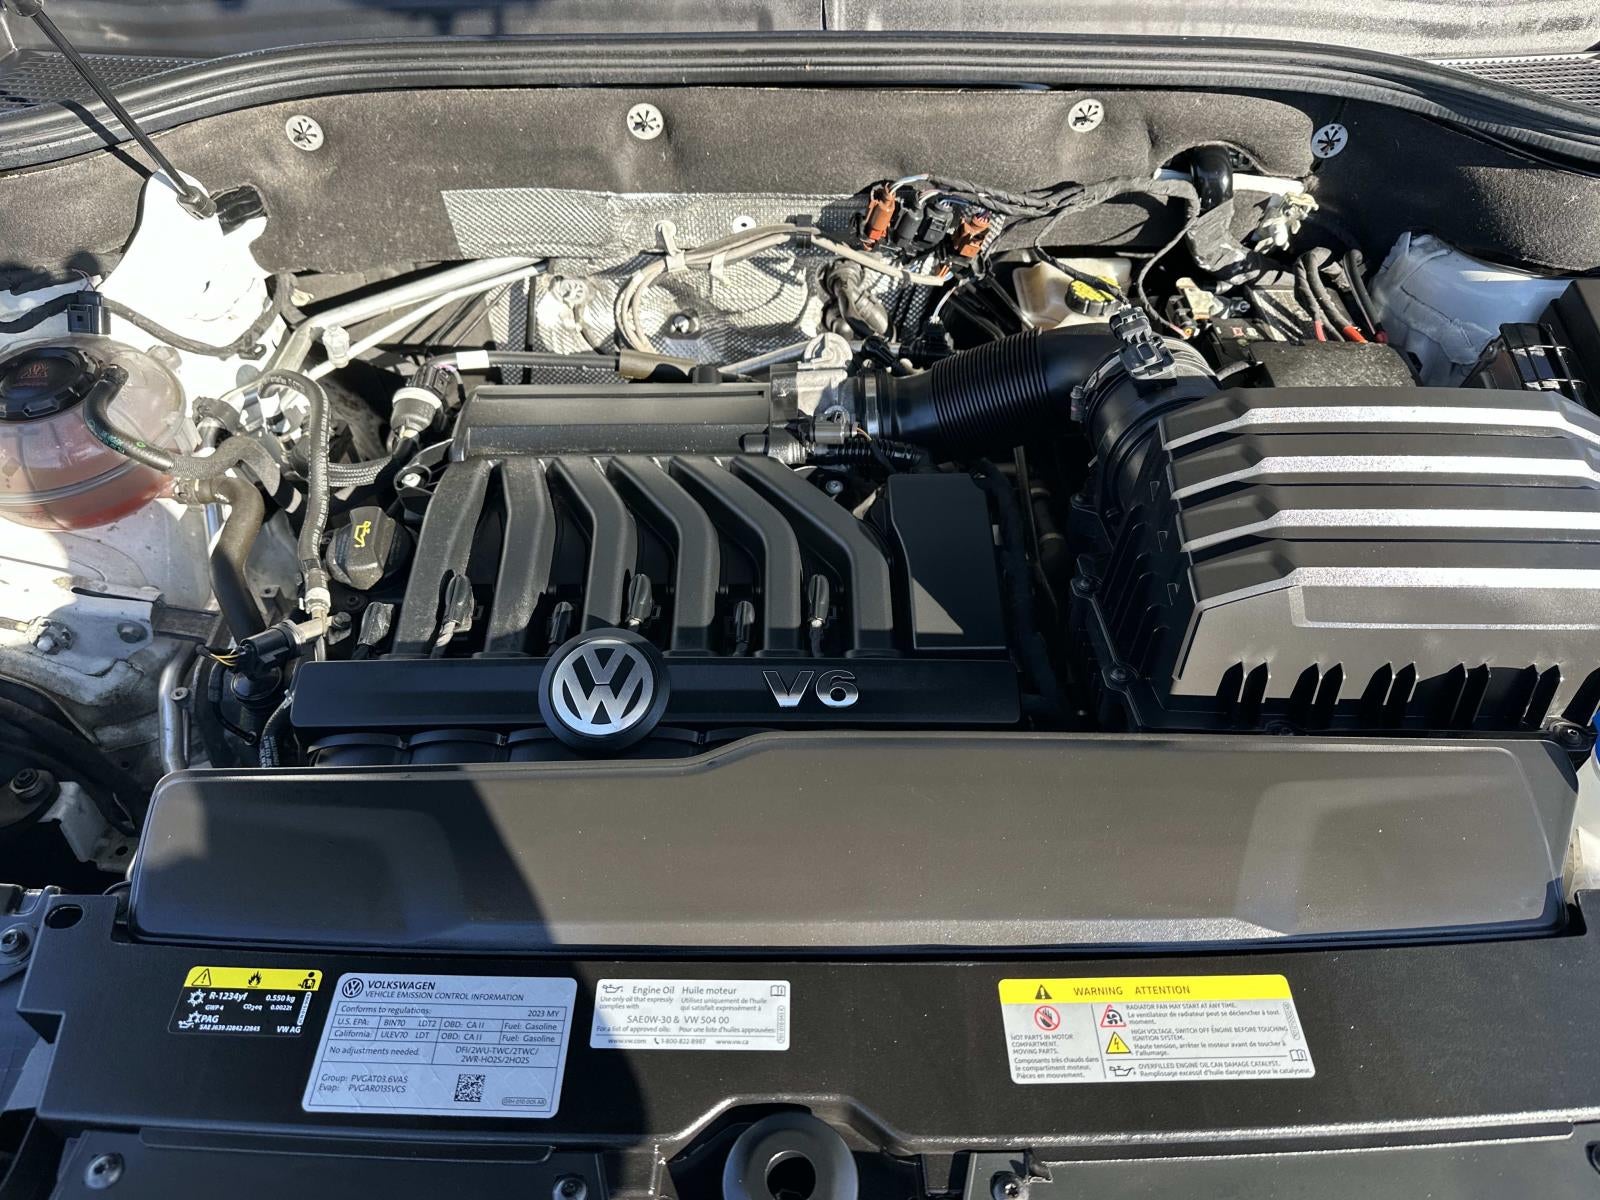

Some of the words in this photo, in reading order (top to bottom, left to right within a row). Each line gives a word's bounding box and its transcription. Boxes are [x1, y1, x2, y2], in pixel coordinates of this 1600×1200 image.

[763, 669, 859, 708] V6
[368, 980, 436, 990] VOLKSWAGEN
[396, 991, 432, 999] EMISSION
[632, 986, 660, 996] Engine
[682, 986, 704, 994] Huile
[1074, 986, 1123, 996] WARNING
[1136, 986, 1190, 994] ATTENTION
[209, 992, 248, 1002] R-1234yf
[286, 995, 296, 1003] kg
[341, 1005, 376, 1013] Conforms
[388, 1006, 432, 1015] regulations:
[200, 1014, 220, 1023] PAG
[700, 1016, 716, 1024] 504
[718, 1016, 730, 1024] 00
[444, 1020, 461, 1028] OBD:
[342, 1047, 388, 1057] adjustments
[322, 1074, 346, 1083] Group:
[319, 1083, 339, 1092] Evap:
